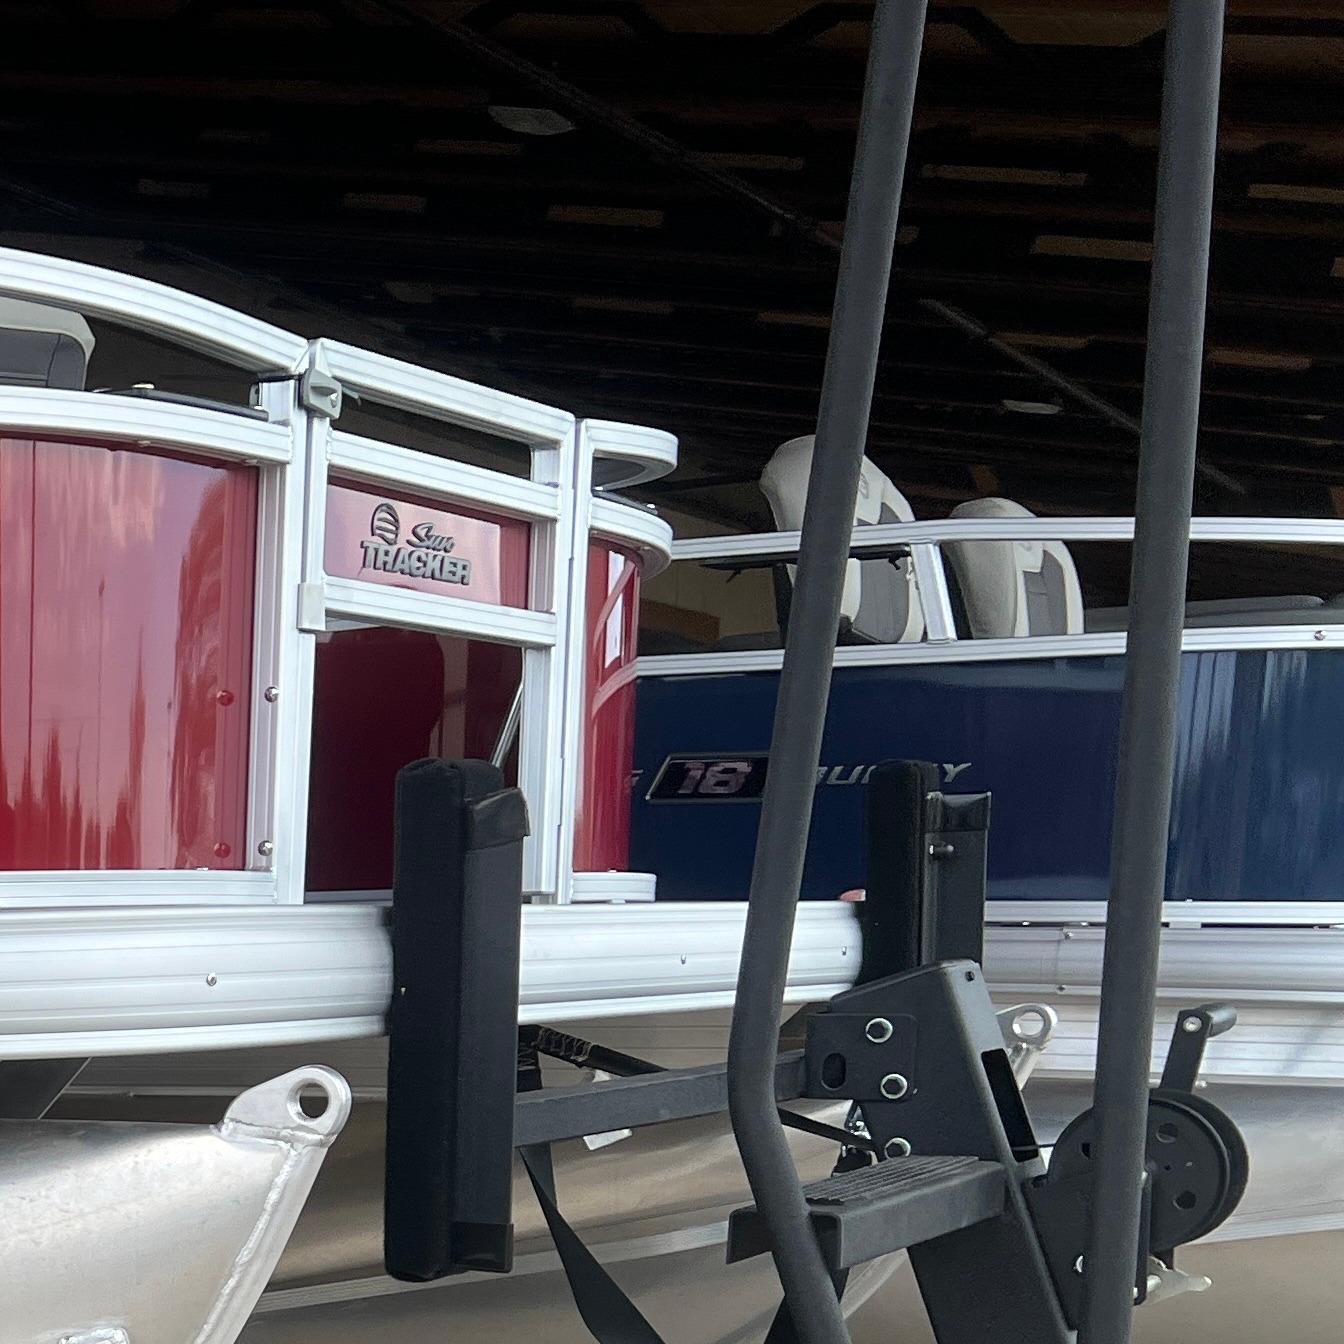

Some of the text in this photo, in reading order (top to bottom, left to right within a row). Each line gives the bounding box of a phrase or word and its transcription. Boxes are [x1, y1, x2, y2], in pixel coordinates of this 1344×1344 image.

[406, 522, 456, 553] Sun
[360, 540, 472, 586] TRACKER
[678, 761, 753, 794] 18
